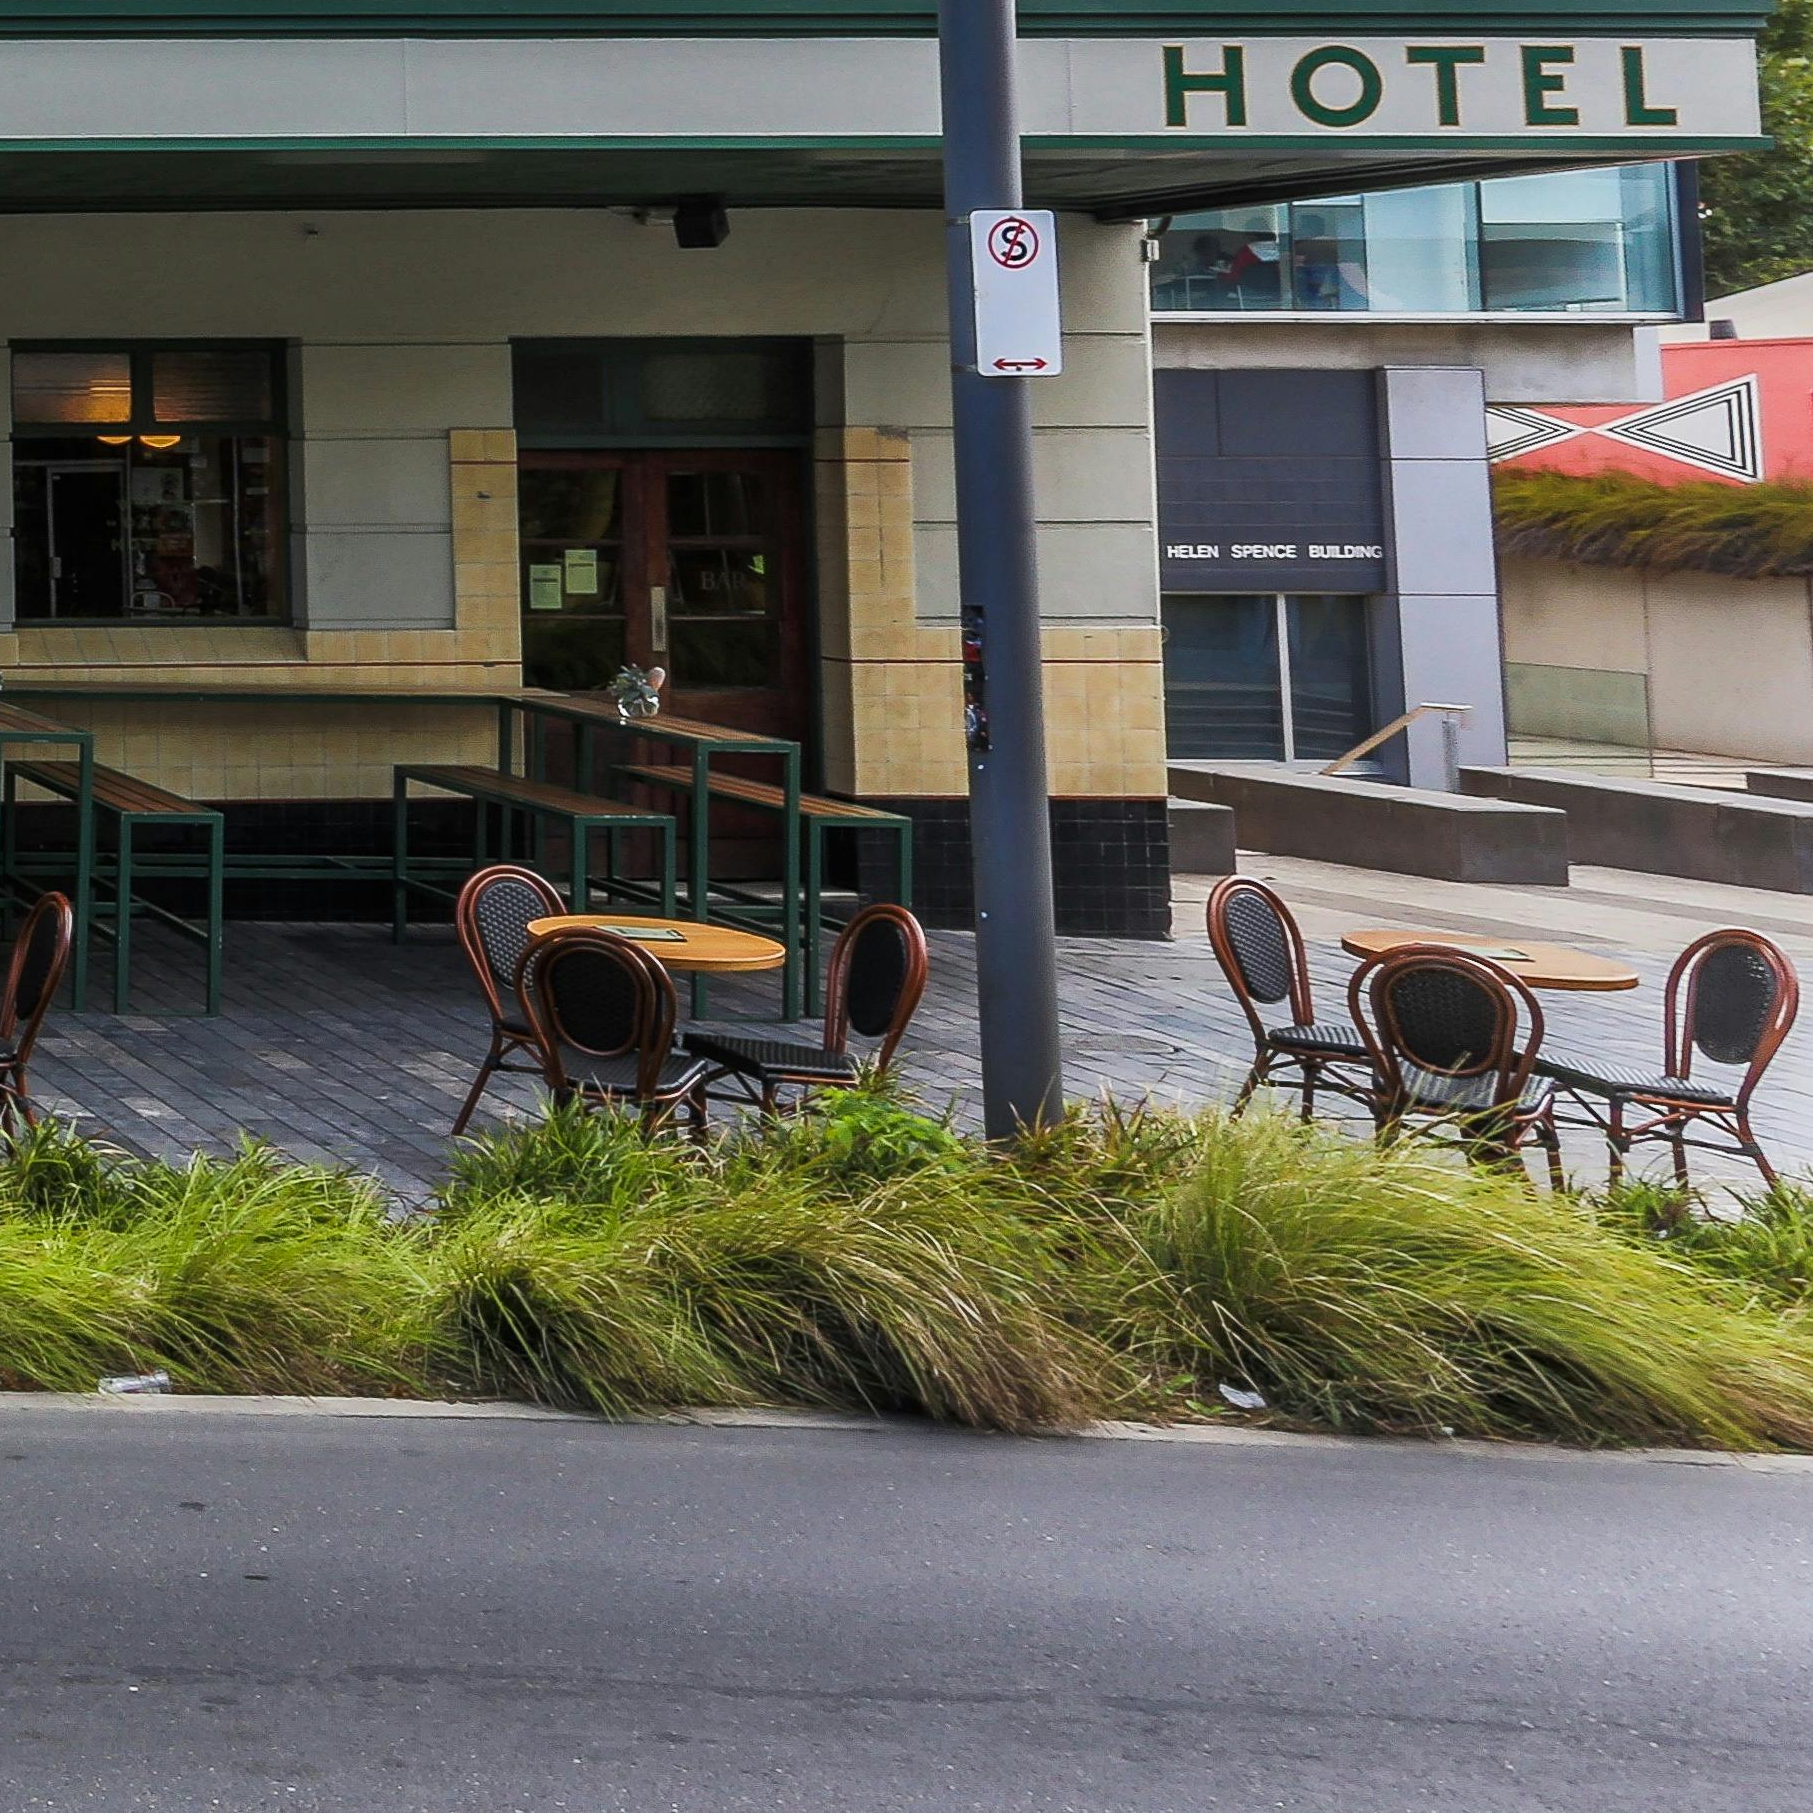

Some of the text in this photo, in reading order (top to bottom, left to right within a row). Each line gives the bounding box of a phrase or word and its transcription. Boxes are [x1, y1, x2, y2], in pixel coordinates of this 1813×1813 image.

[1162, 45, 1678, 129] HOTEL
[1167, 544, 1383, 559] HELEN SPENCE BUILDING
[700, 571, 745, 591] BAR
